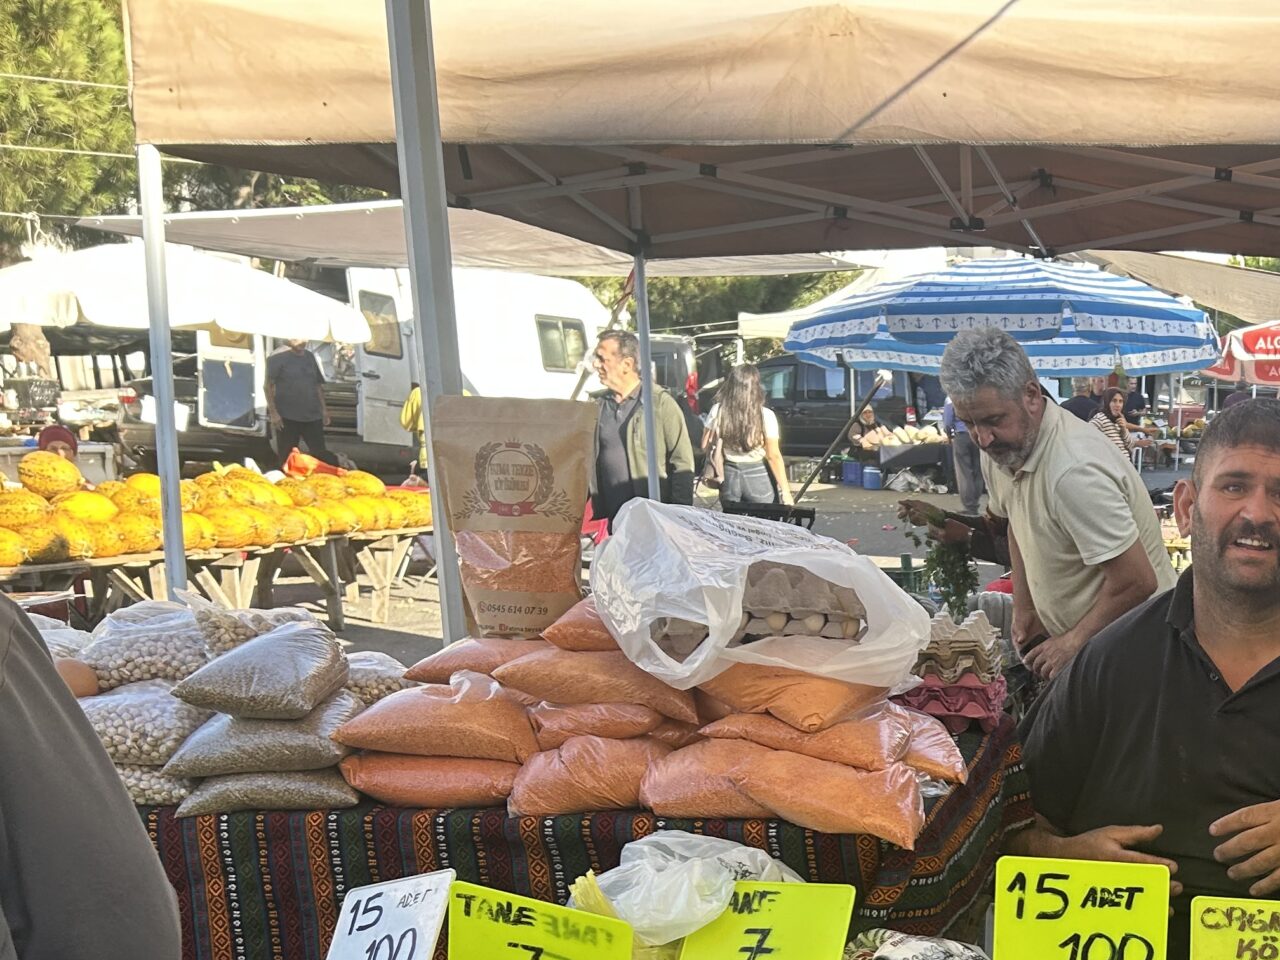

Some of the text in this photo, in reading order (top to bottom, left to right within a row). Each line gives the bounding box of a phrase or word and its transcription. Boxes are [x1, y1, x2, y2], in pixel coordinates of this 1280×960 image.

[487, 603, 548, 616] 0545 614 07 39
[456, 893, 537, 927] TANE
[728, 889, 782, 914] ANE
[1006, 871, 1145, 920] 15 ADET
[348, 892, 384, 936] 15
